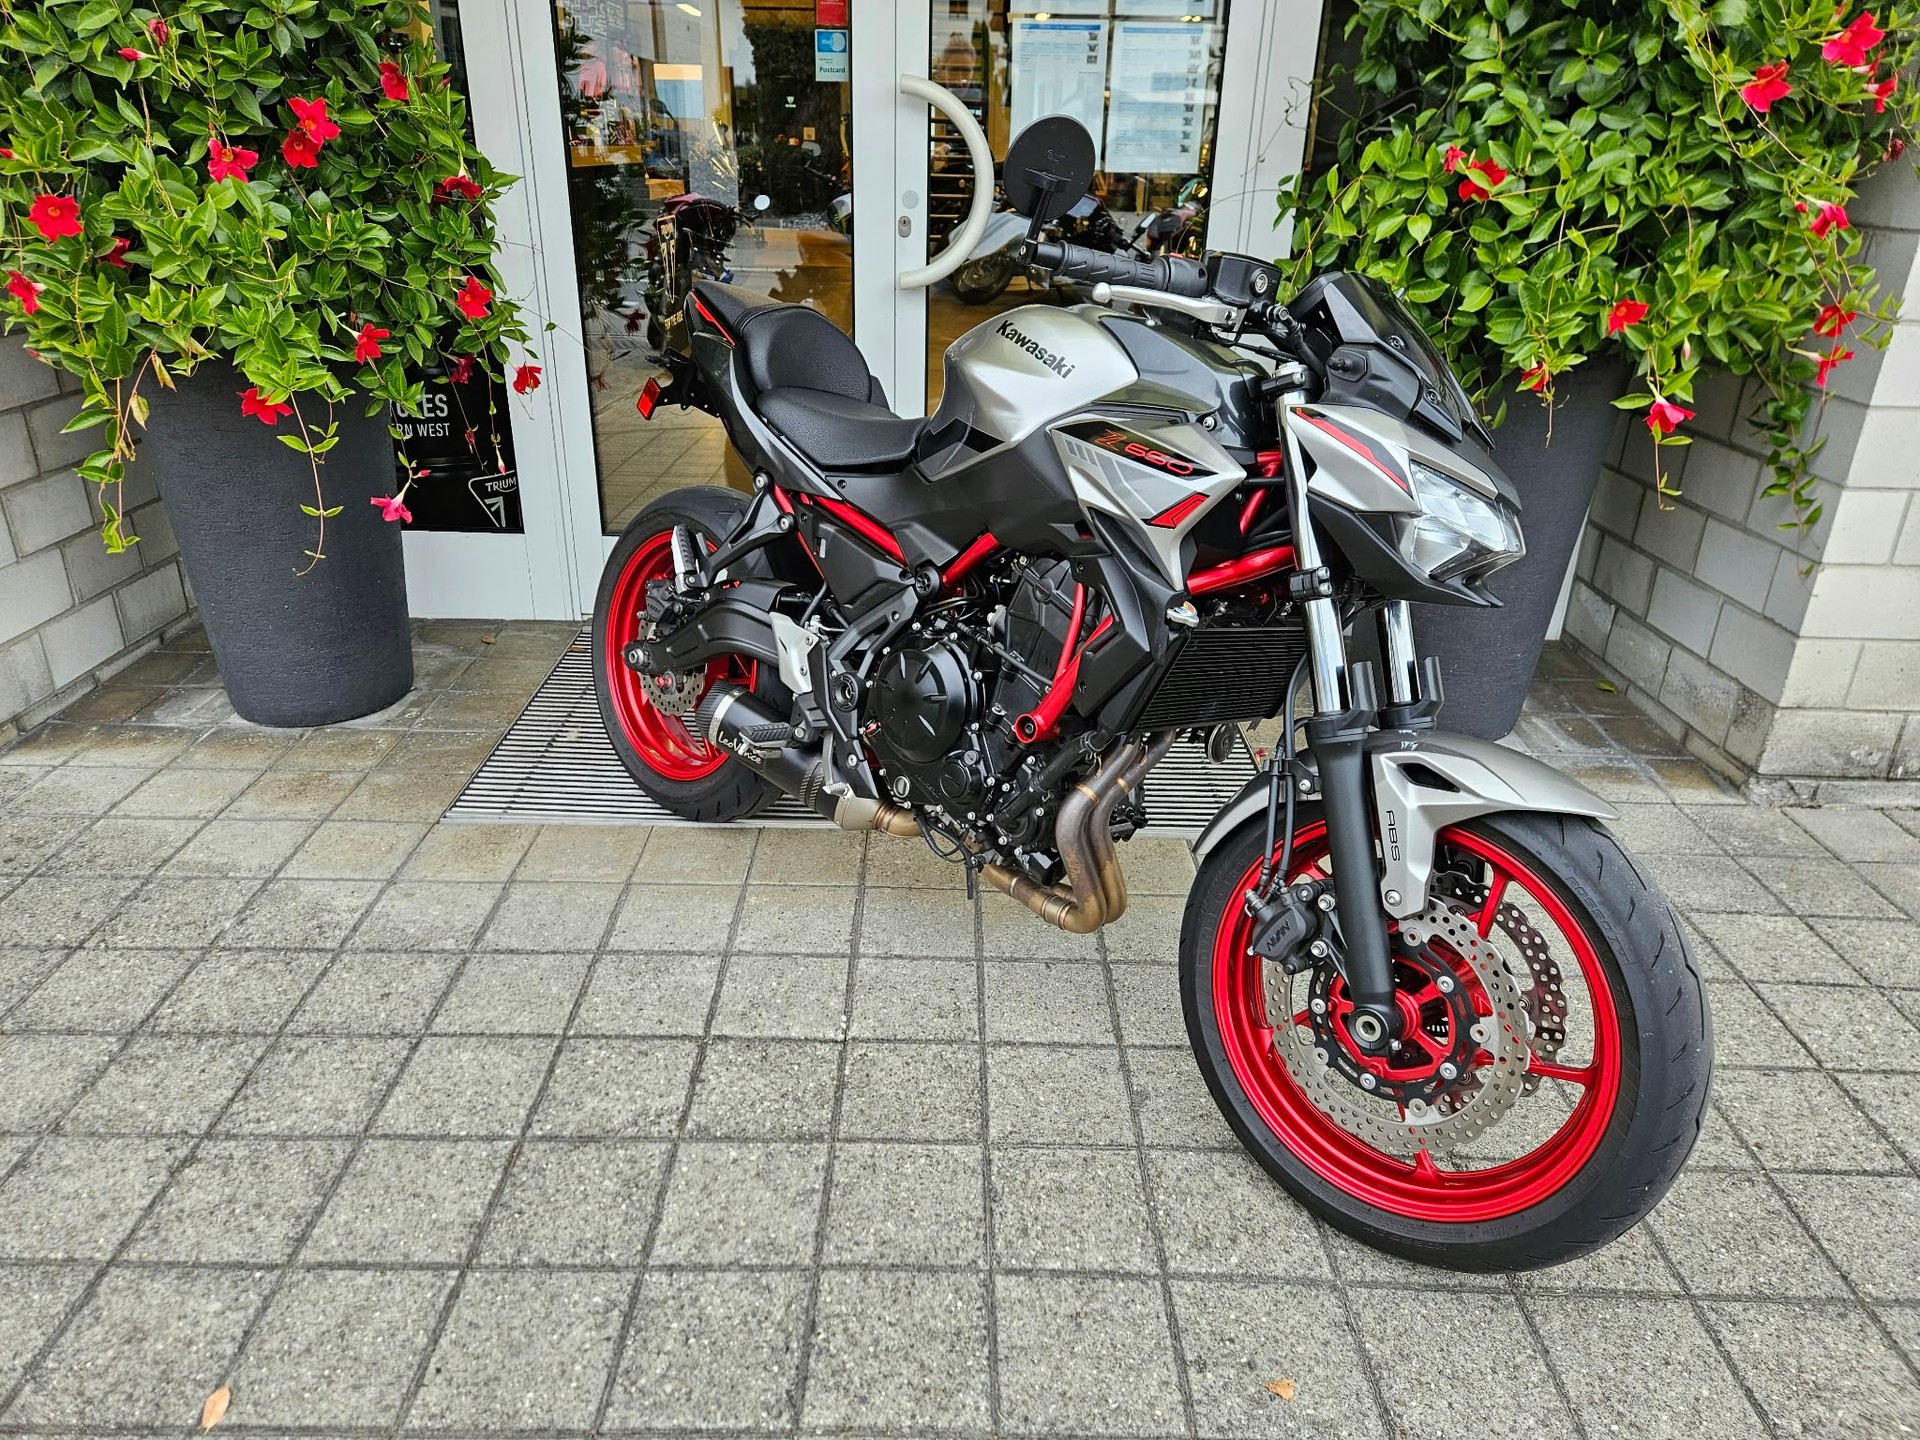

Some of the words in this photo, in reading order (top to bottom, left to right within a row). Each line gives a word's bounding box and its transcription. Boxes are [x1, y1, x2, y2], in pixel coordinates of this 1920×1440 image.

[995, 319, 1076, 379] Kawasaki
[391, 423, 413, 437] RN
[416, 422, 450, 437] WEST
[718, 730, 762, 764] LeoVnce
[1386, 810, 1400, 861] ABS
